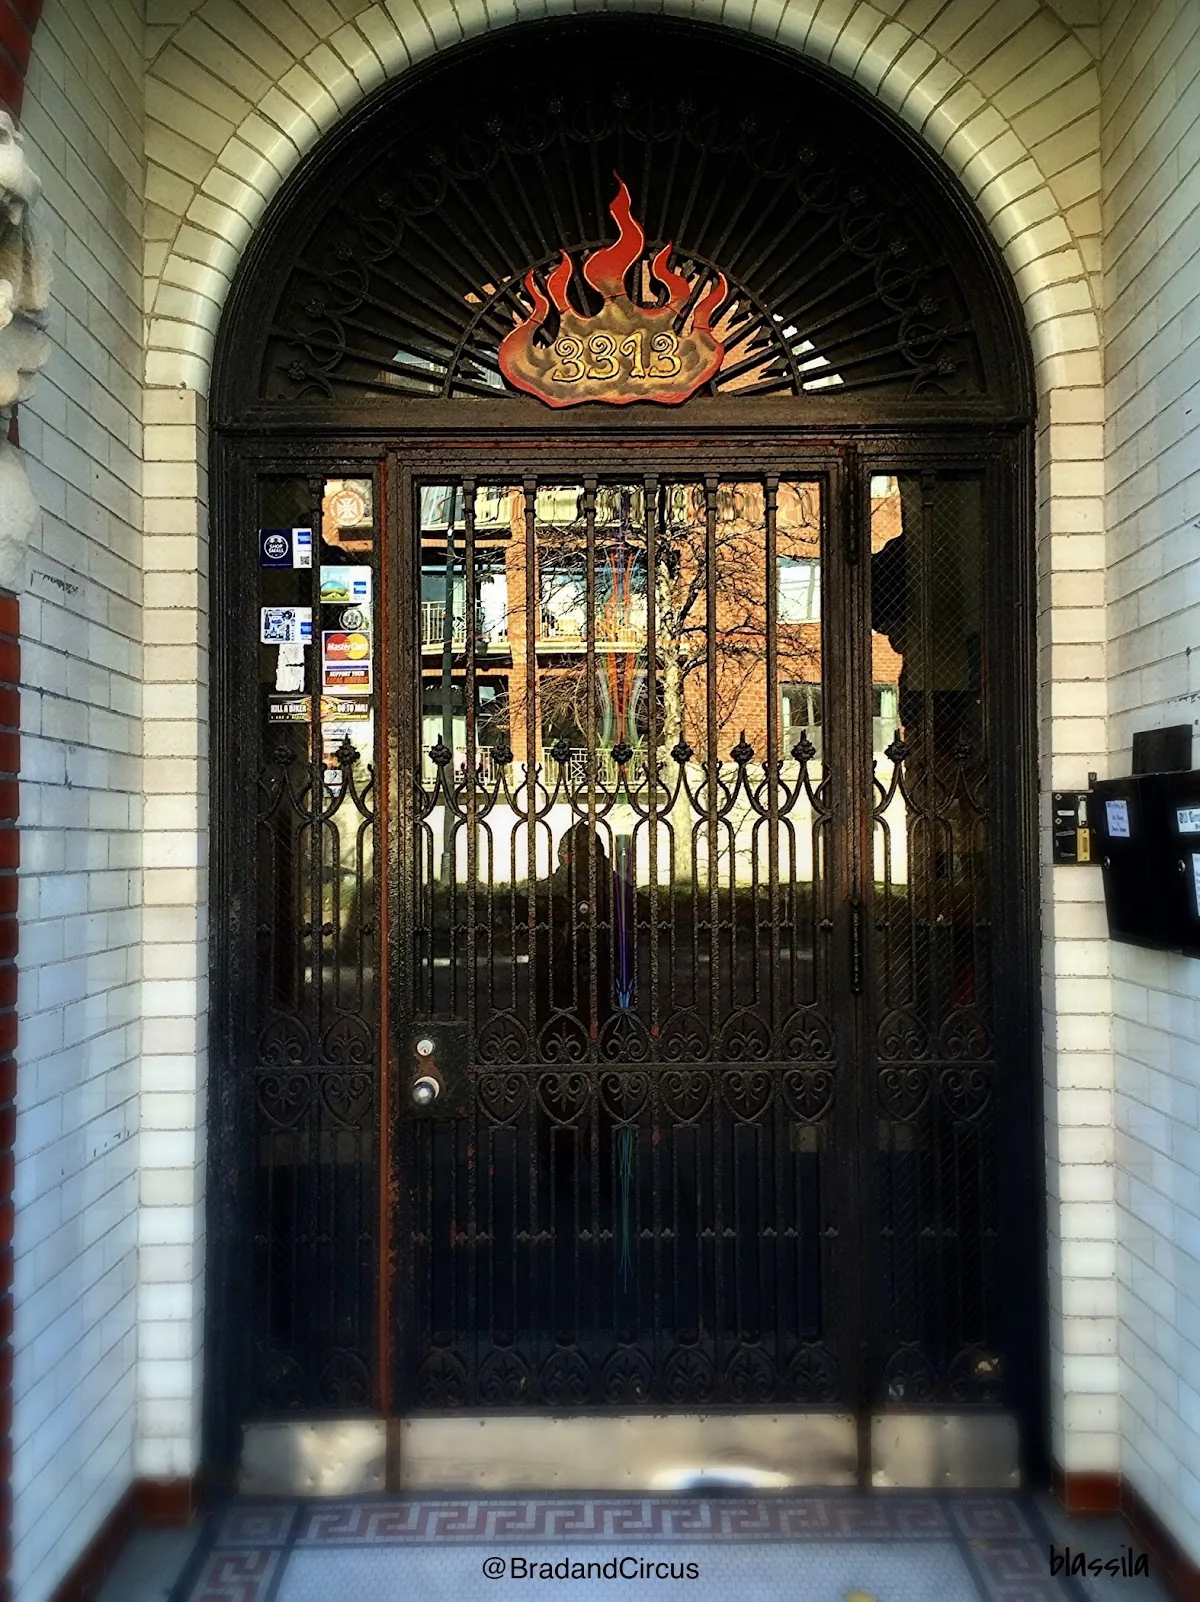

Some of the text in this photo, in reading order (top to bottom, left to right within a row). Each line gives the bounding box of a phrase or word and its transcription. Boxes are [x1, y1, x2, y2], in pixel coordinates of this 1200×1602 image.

[552, 328, 683, 383] 3313
[326, 642, 369, 652] MasterCard
[271, 704, 283, 713] KILL
[284, 704, 288, 713] A
[289, 704, 307, 713] BIKER
